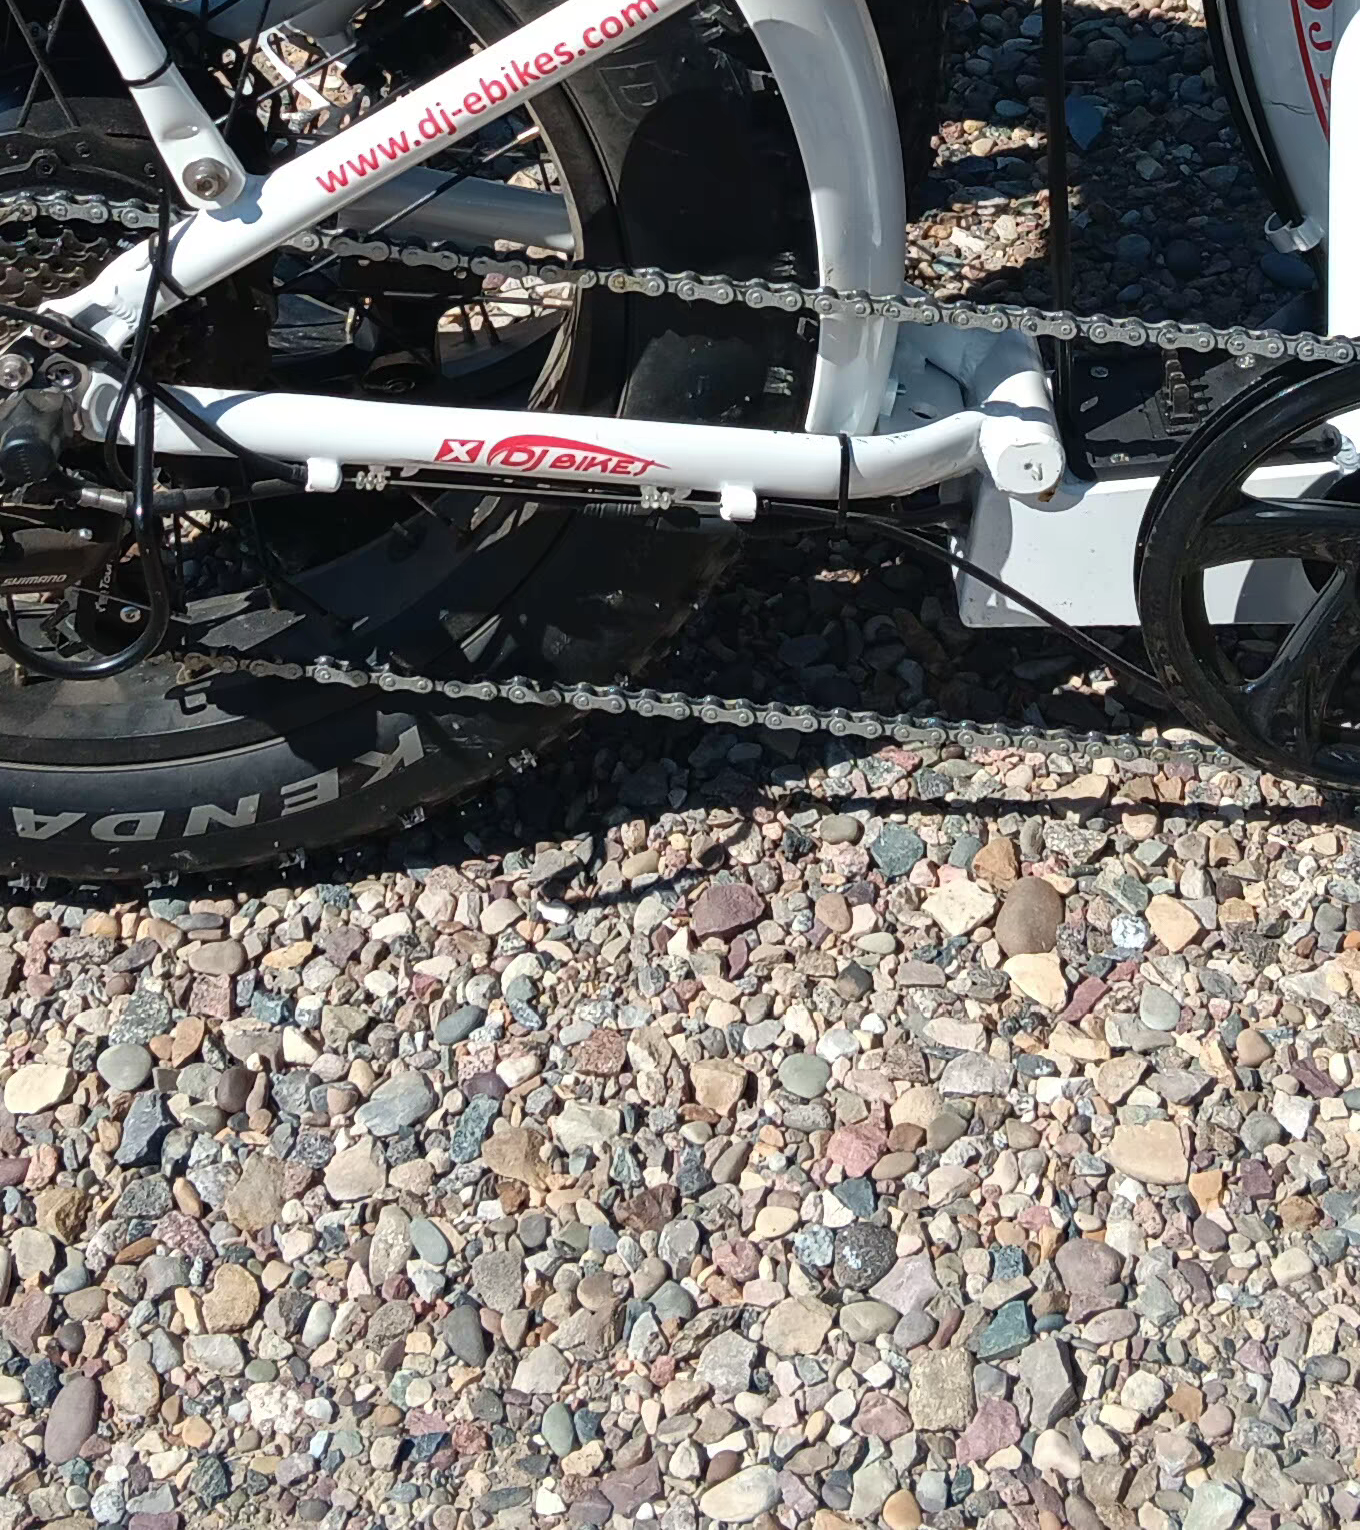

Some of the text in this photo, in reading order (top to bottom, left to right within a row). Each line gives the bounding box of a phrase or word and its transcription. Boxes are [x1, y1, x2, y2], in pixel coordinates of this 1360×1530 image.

[498, 446, 550, 471] DJ
[0, 573, 69, 588] SHIMANO
[11, 725, 428, 843] KENDA
